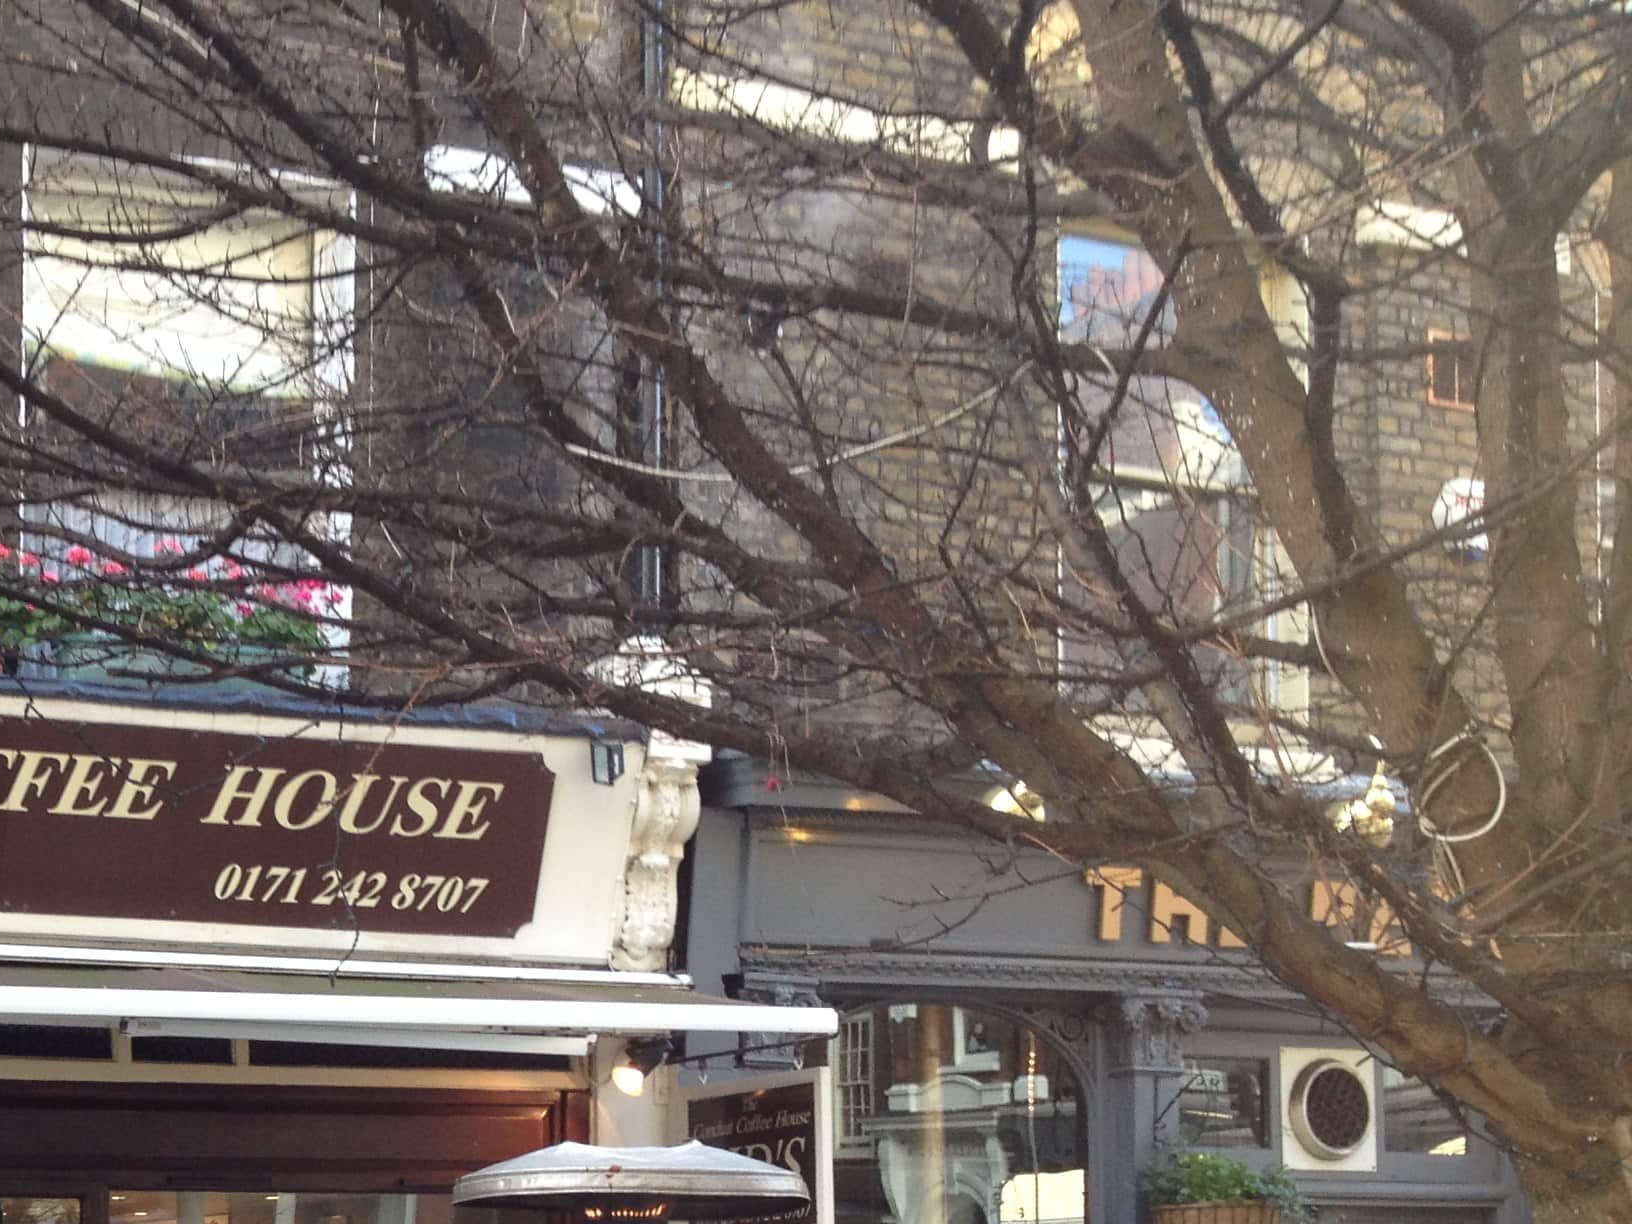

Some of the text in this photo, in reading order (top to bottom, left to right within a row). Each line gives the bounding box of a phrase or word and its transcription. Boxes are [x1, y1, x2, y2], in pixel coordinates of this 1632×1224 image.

[200, 764, 505, 842] HOUSE
[214, 863, 489, 915] 0171 242 8707
